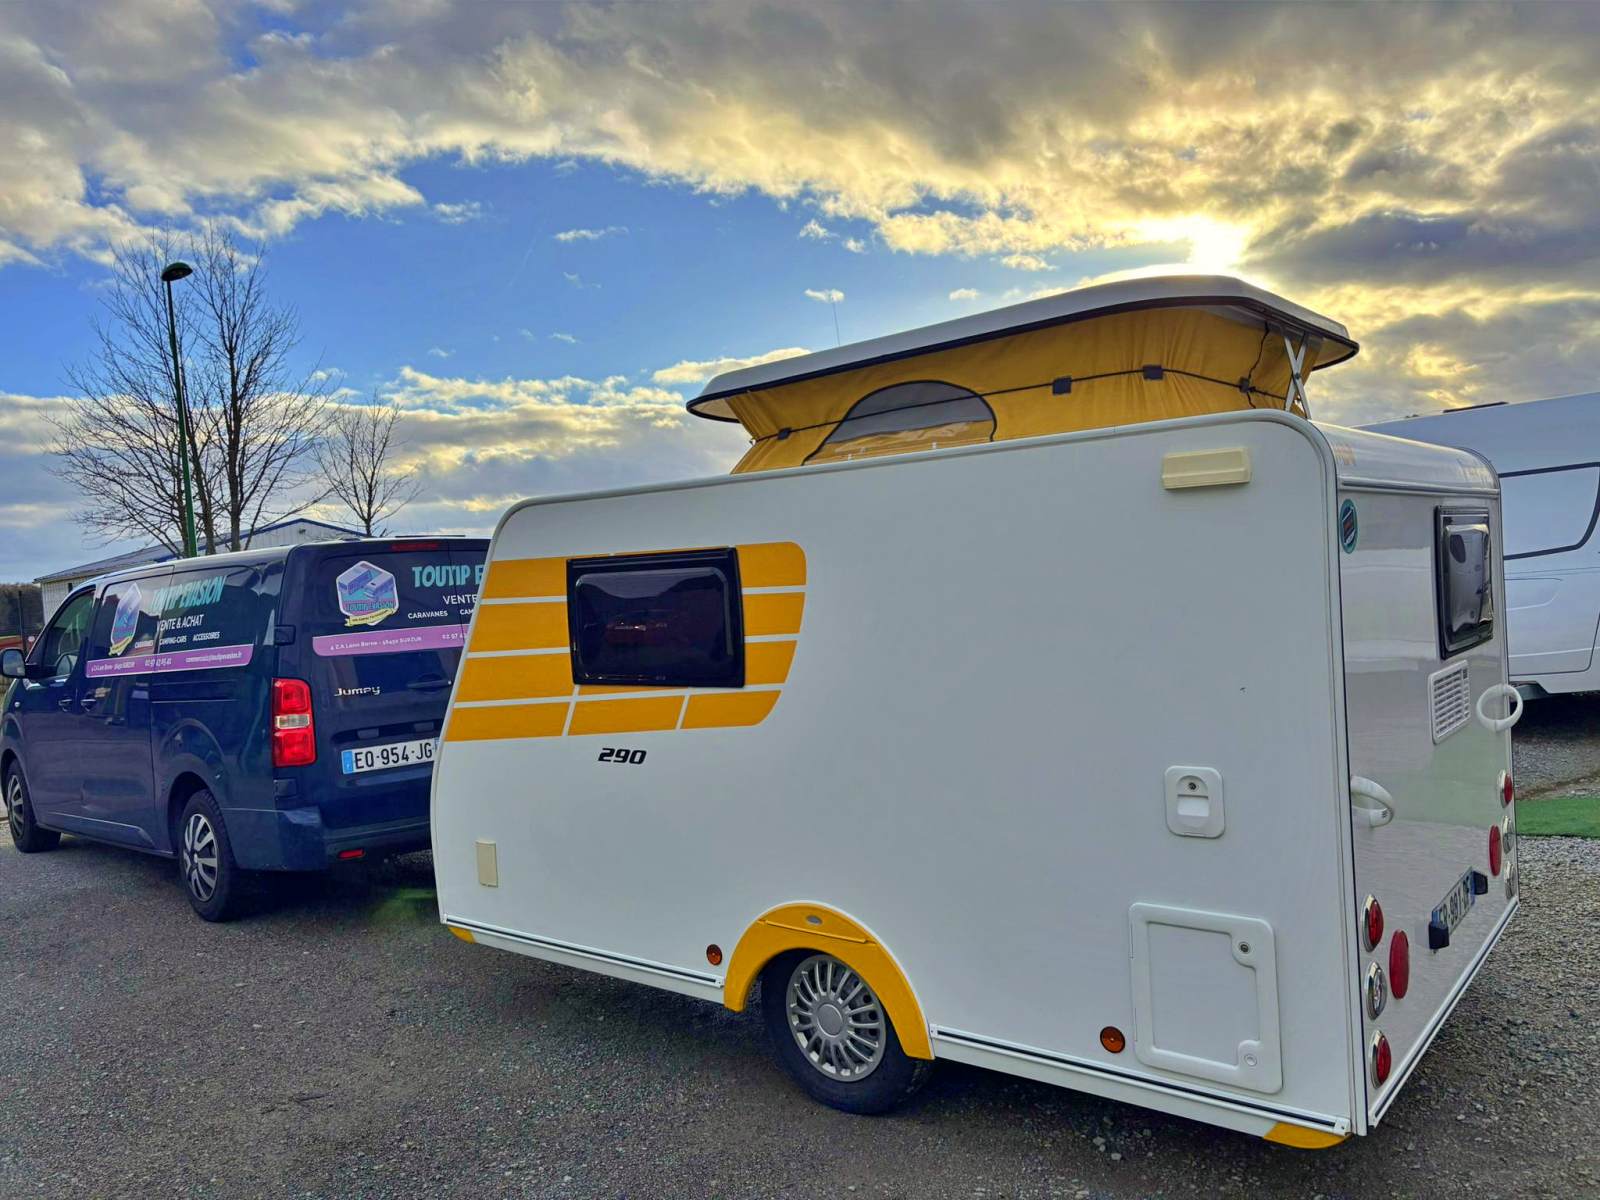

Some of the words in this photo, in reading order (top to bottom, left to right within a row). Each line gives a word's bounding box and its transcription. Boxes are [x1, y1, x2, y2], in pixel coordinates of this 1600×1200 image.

[412, 564, 471, 588] TOUTIP
[443, 594, 479, 605] VENTE
[408, 610, 448, 619] CARAVANES
[182, 614, 204, 629] ACHAT
[334, 686, 380, 697] Jumpy
[598, 747, 647, 765] 290
